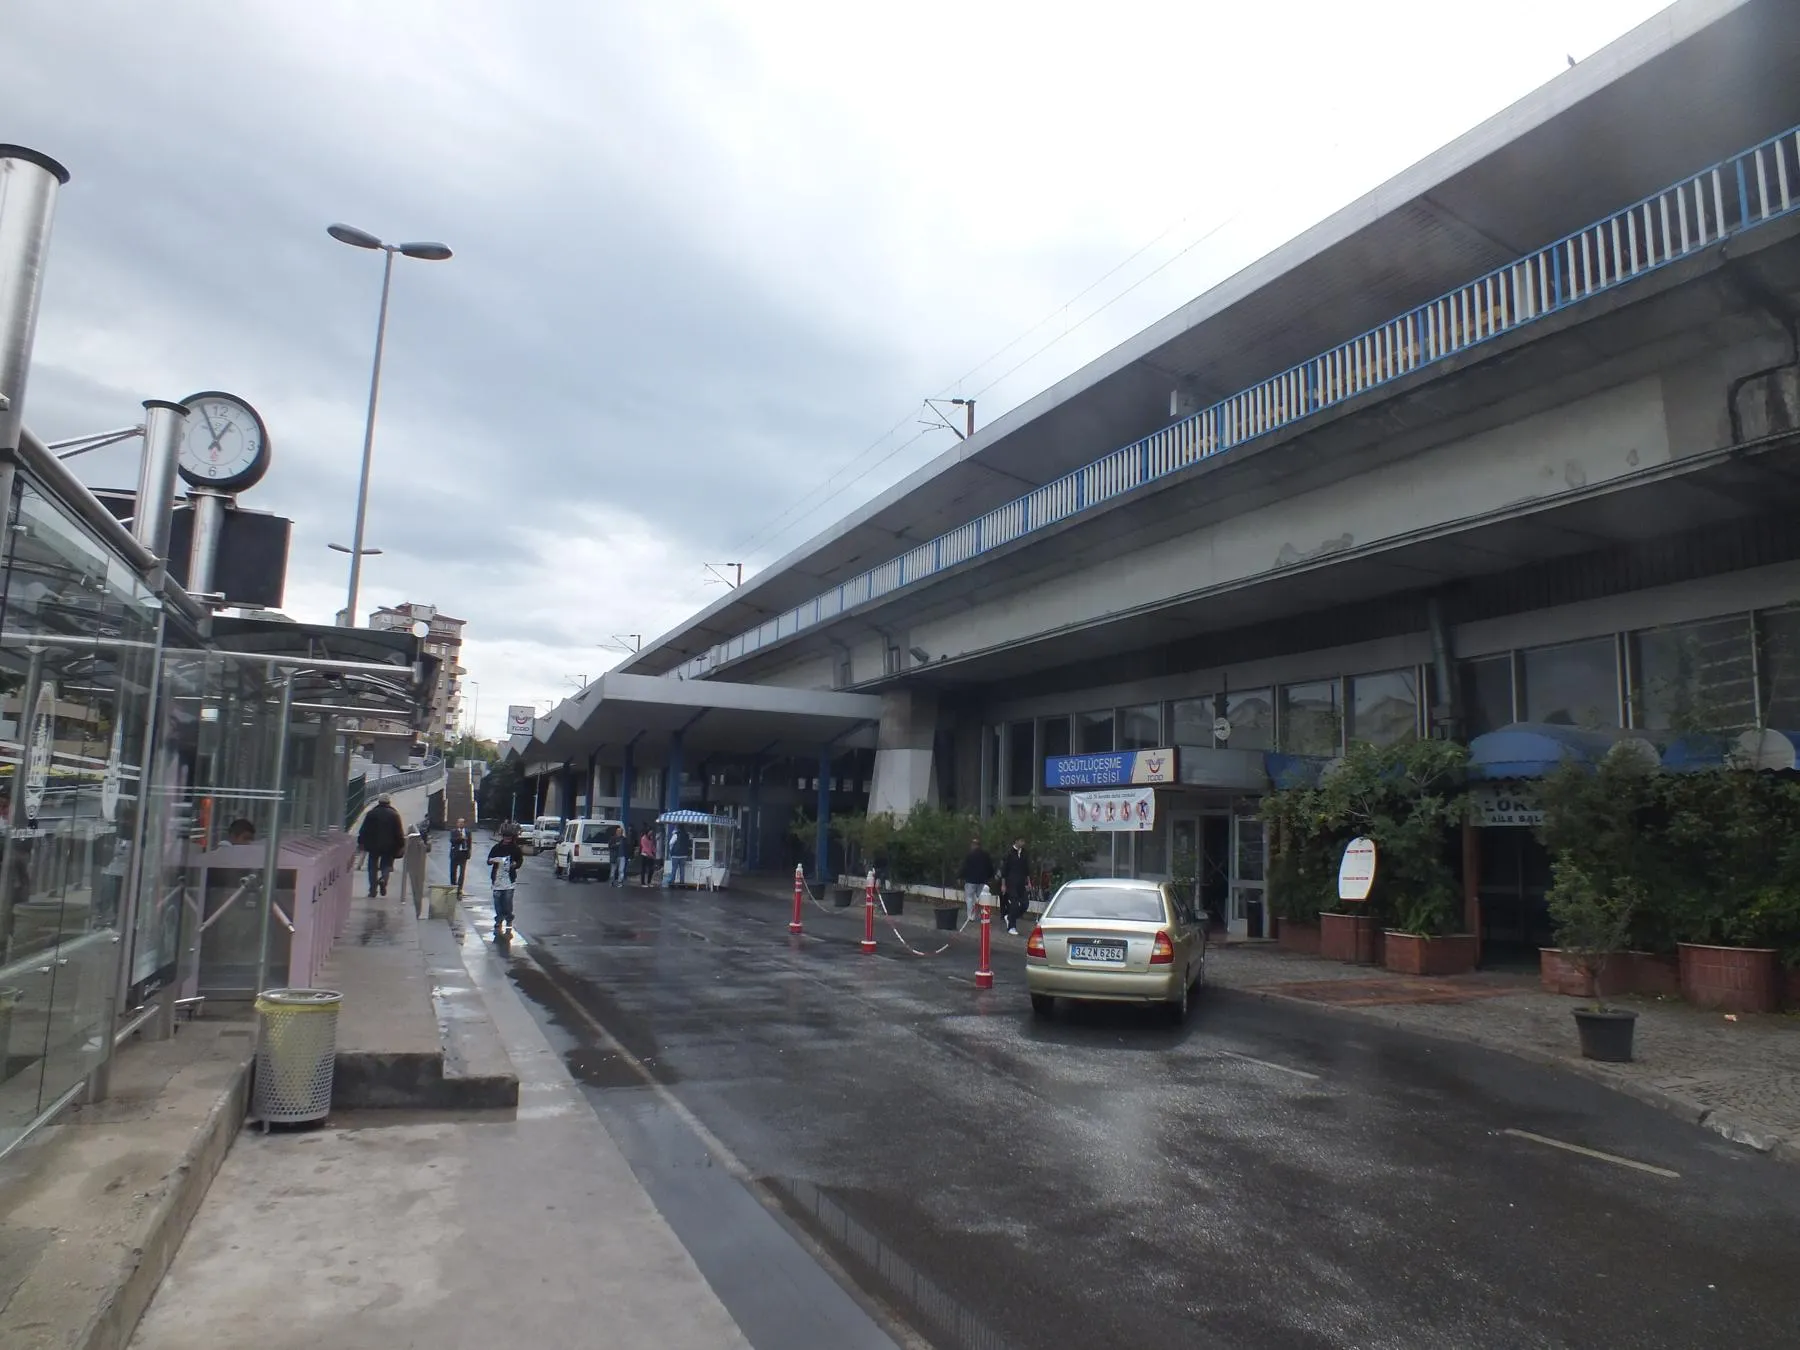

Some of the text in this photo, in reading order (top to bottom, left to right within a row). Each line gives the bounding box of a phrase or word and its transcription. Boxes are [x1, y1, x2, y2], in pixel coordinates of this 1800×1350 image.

[213, 405, 229, 417] 12
[247, 440, 256, 451] 3
[208, 467, 217, 477] 6
[1058, 757, 1122, 773] SÖĞÜTLÜÇEŞME
[1059, 771, 1120, 786] SOSYAL TESİSİ
[1076, 947, 1086, 957] 34
